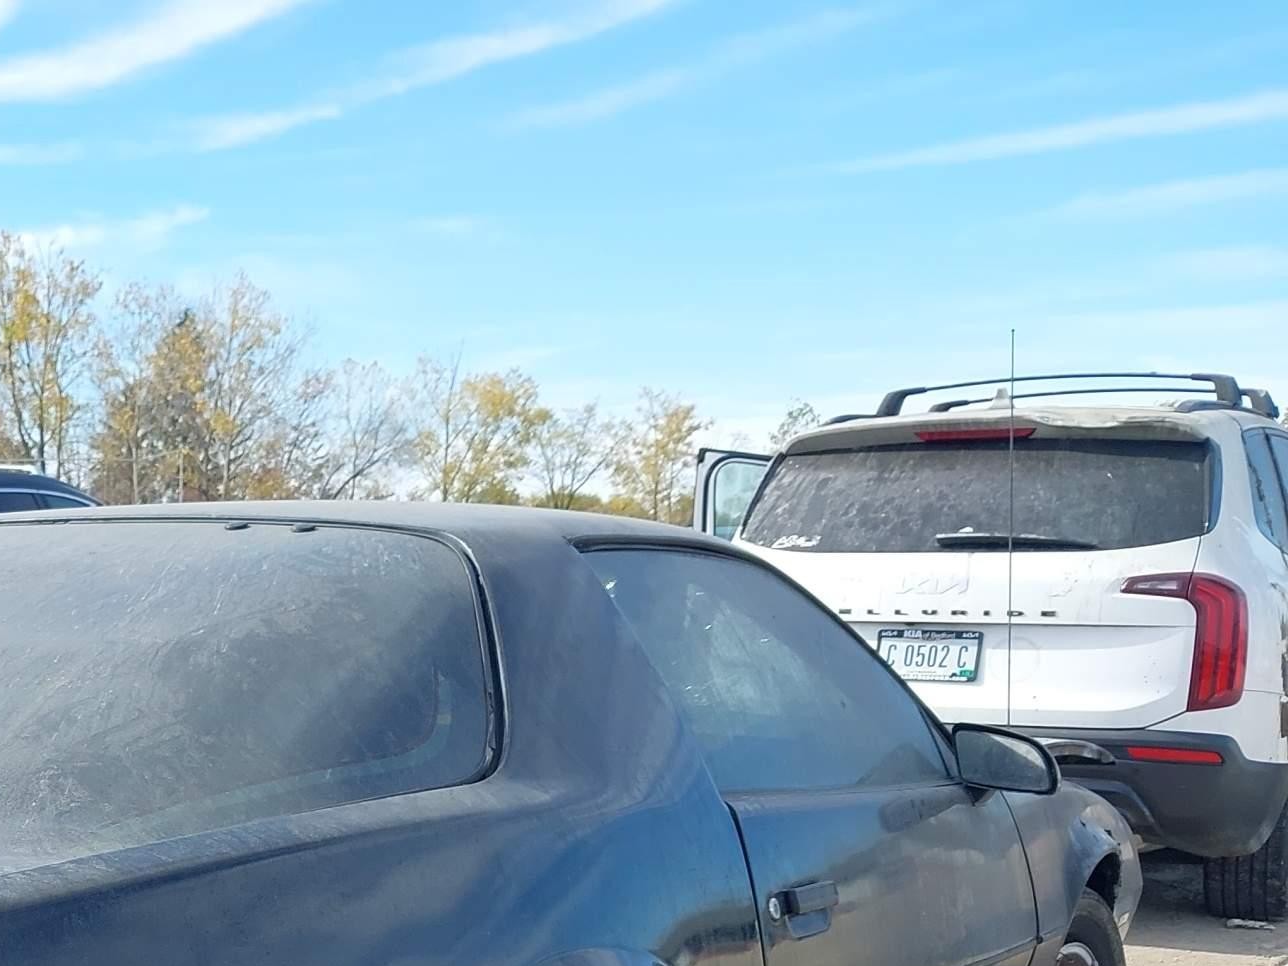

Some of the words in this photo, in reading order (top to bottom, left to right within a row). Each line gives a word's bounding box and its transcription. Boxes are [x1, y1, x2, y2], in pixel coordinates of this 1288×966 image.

[838, 608, 1057, 618] ELLURIDE
[904, 630, 922, 638] KIA
[904, 644, 950, 668] 0502
[957, 645, 969, 668] C
